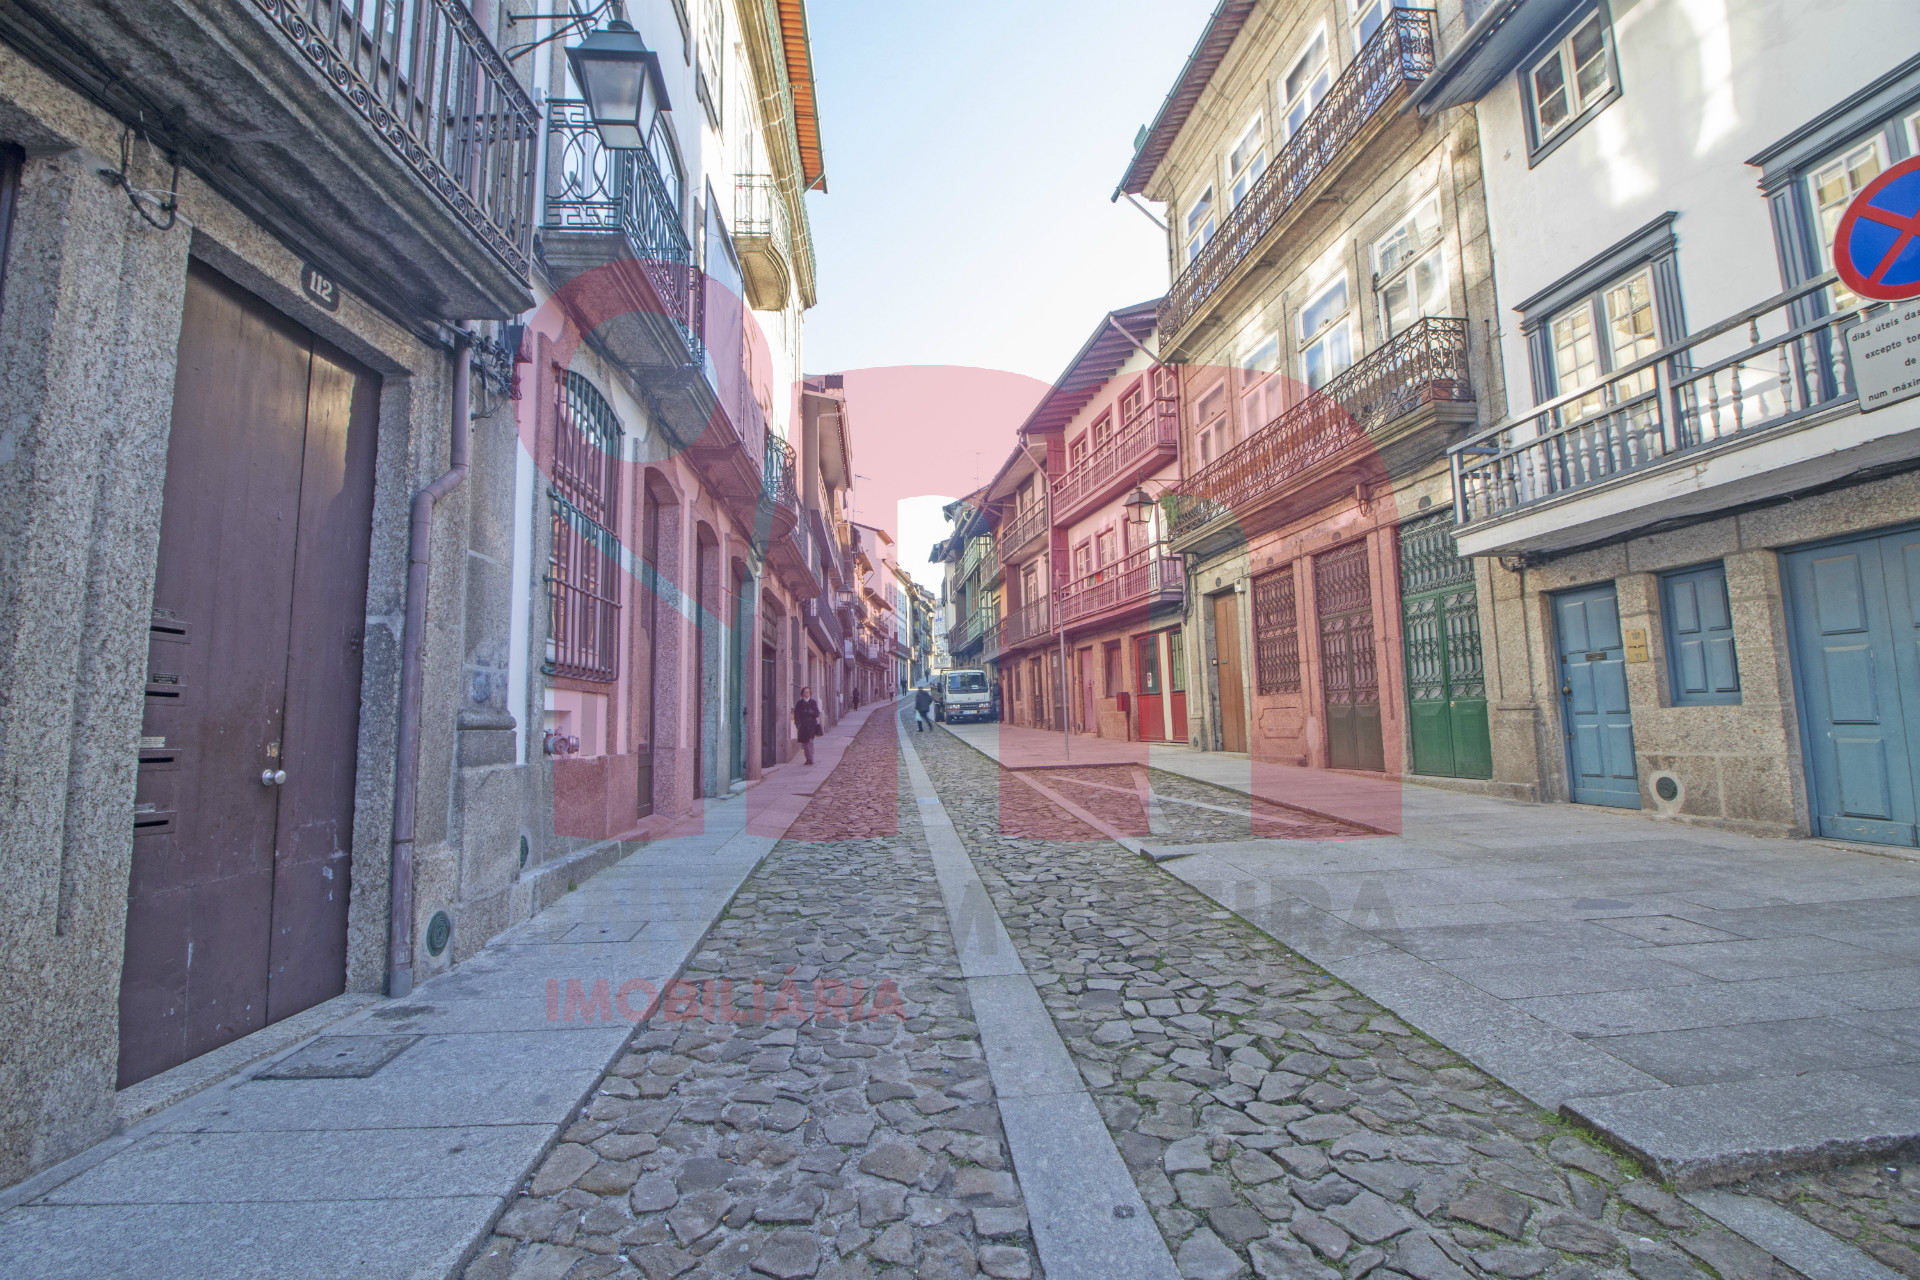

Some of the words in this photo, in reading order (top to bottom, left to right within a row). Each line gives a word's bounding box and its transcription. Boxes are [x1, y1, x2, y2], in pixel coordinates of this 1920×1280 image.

[309, 270, 333, 303] 112
[1851, 329, 1871, 342] dias
[1875, 318, 1899, 332] úteis
[1865, 341, 1902, 359] excepto
[1904, 357, 1917, 367] de
[1868, 390, 1888, 401] num
